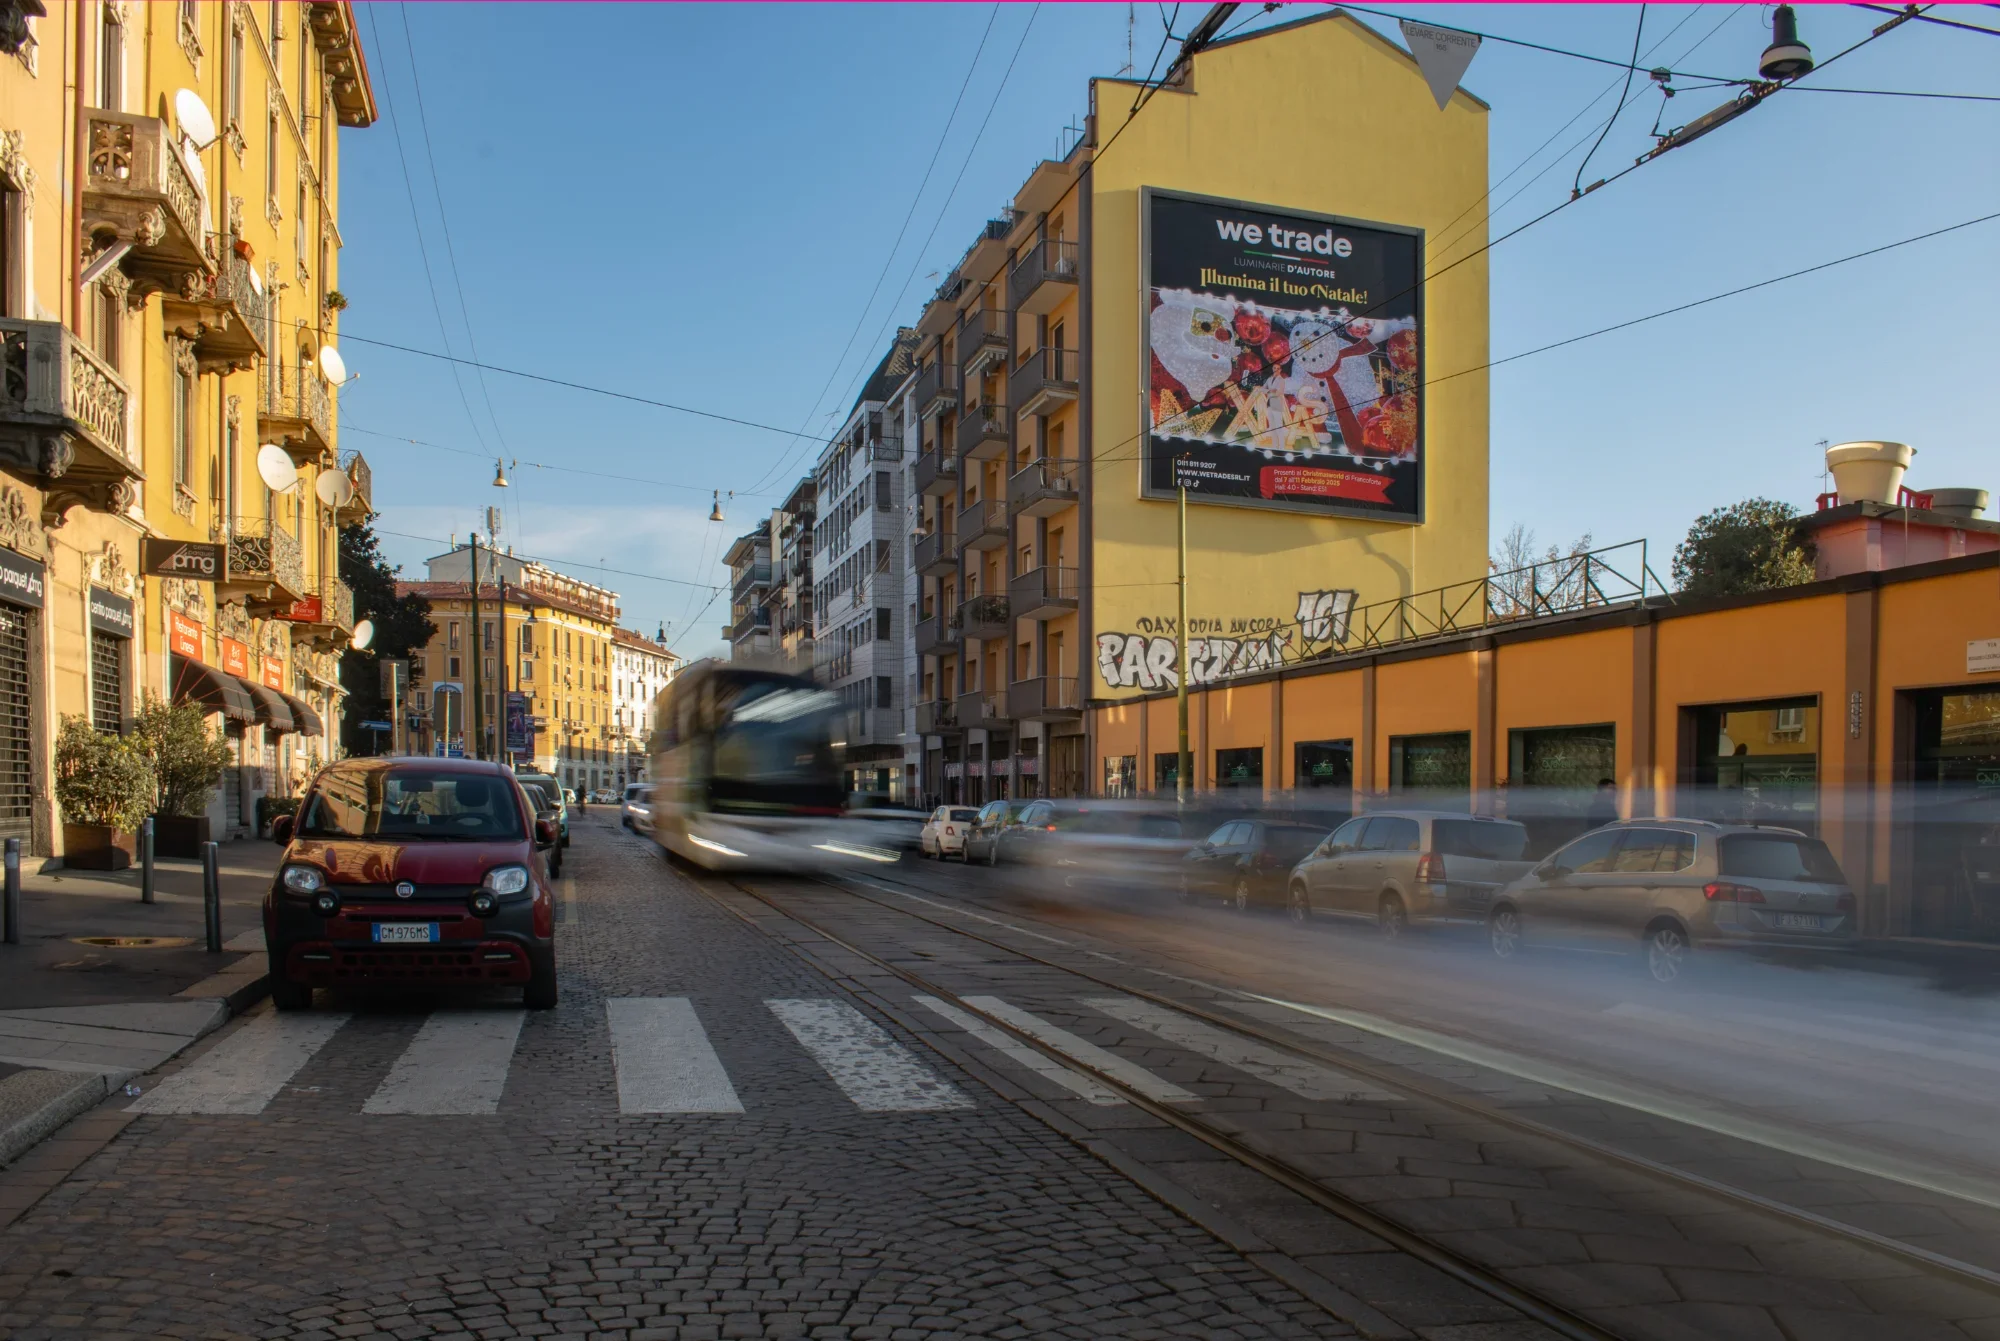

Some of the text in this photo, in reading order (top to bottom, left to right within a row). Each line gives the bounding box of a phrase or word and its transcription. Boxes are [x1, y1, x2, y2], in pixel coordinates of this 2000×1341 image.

[1405, 26, 1476, 48] LEVARE CORRENTE
[1216, 219, 1352, 258] we trade
[1234, 257, 1335, 279] LUMINARIE D'AUTORE
[1200, 268, 1368, 305] Illumina il tuo Natale!
[1177, 469, 1250, 482] WWW.WETRADESRL.IT
[1301, 477, 1325, 485] Febbraio
[1302, 470, 1344, 480] Christmasworld
[1351, 475, 1381, 486] Francoforte
[192, 544, 214, 552] centro
[173, 554, 215, 574] pmg
[4, 567, 27, 589] parquet
[91, 601, 105, 617] centro
[105, 606, 121, 622] parquet
[175, 616, 198, 640] Ristorante
[1189, 617, 1223, 633] ODIA
[1229, 617, 1289, 633] ANCORA
